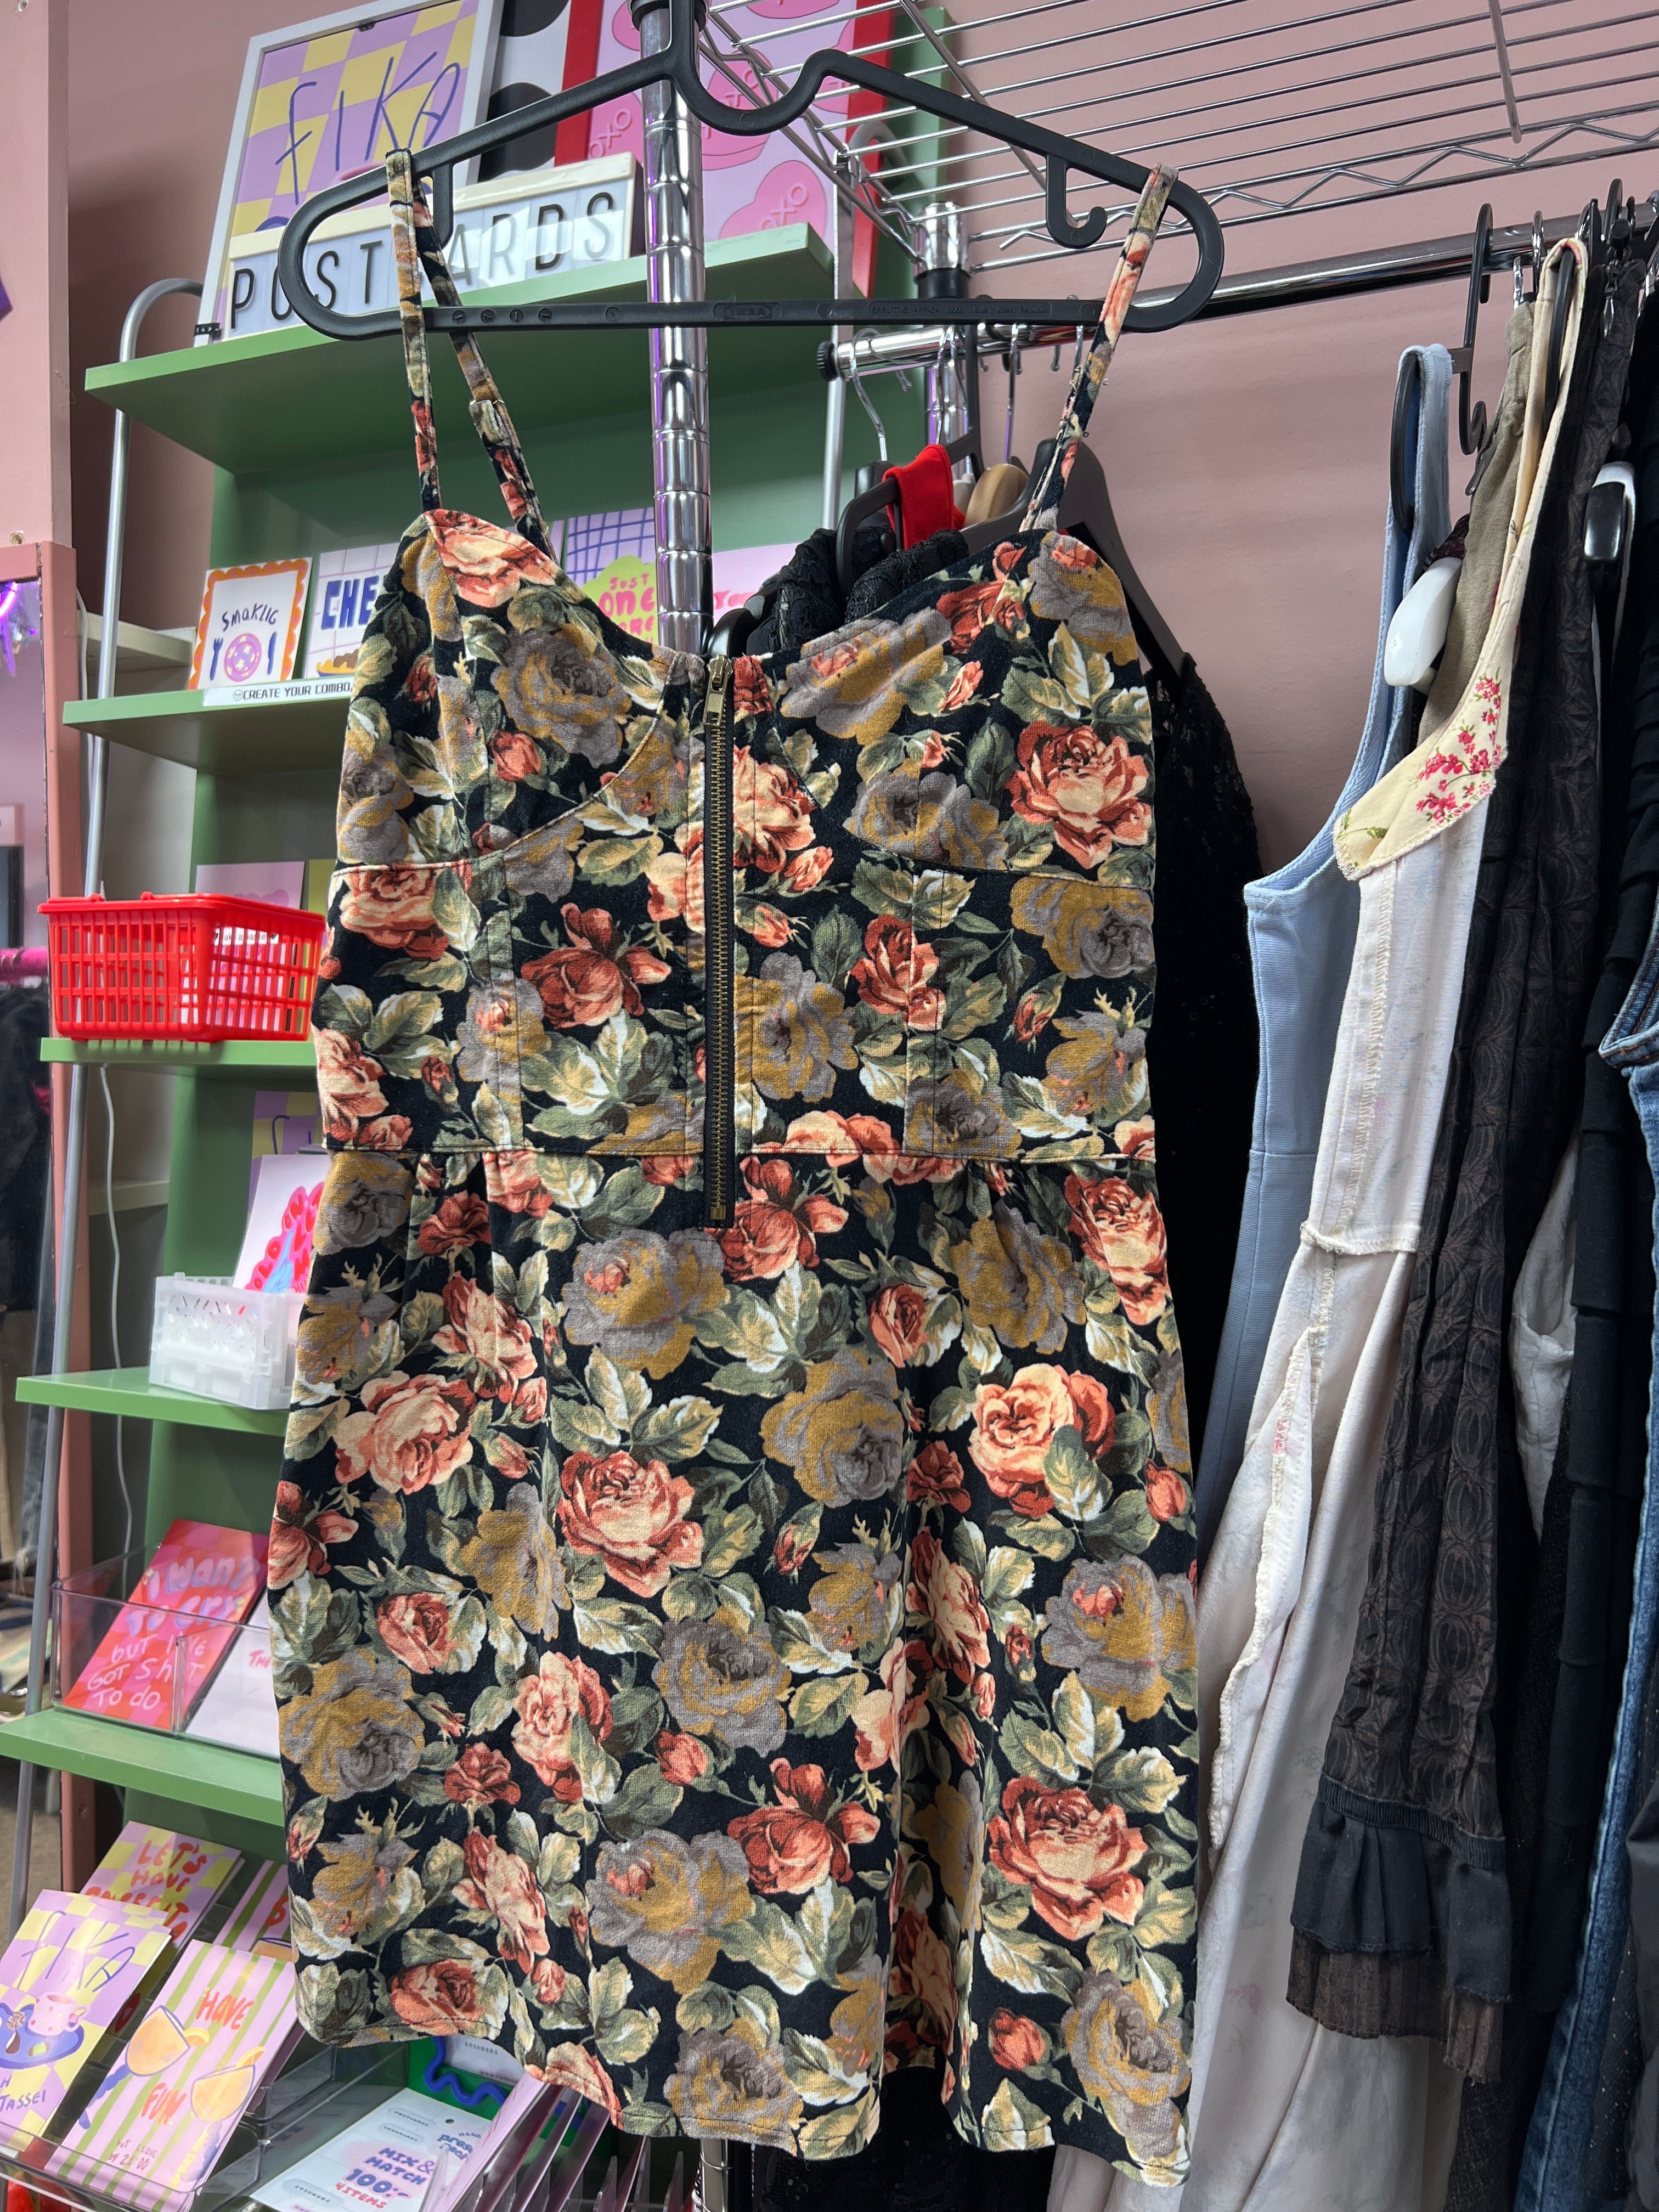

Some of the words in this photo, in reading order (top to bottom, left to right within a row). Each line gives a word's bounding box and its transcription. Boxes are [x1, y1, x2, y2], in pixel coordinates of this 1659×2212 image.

[276, 51, 460, 205] FIKA
[231, 192, 615, 329] POSTARDS
[243, 688, 281, 700] CREATE
[285, 686, 311, 697] YOUR
[135, 1657, 206, 1683] ShT
[141, 2082, 187, 2125] FUN
[364, 2155, 427, 2186] MATCH
[379, 2147, 419, 2167] MIX
